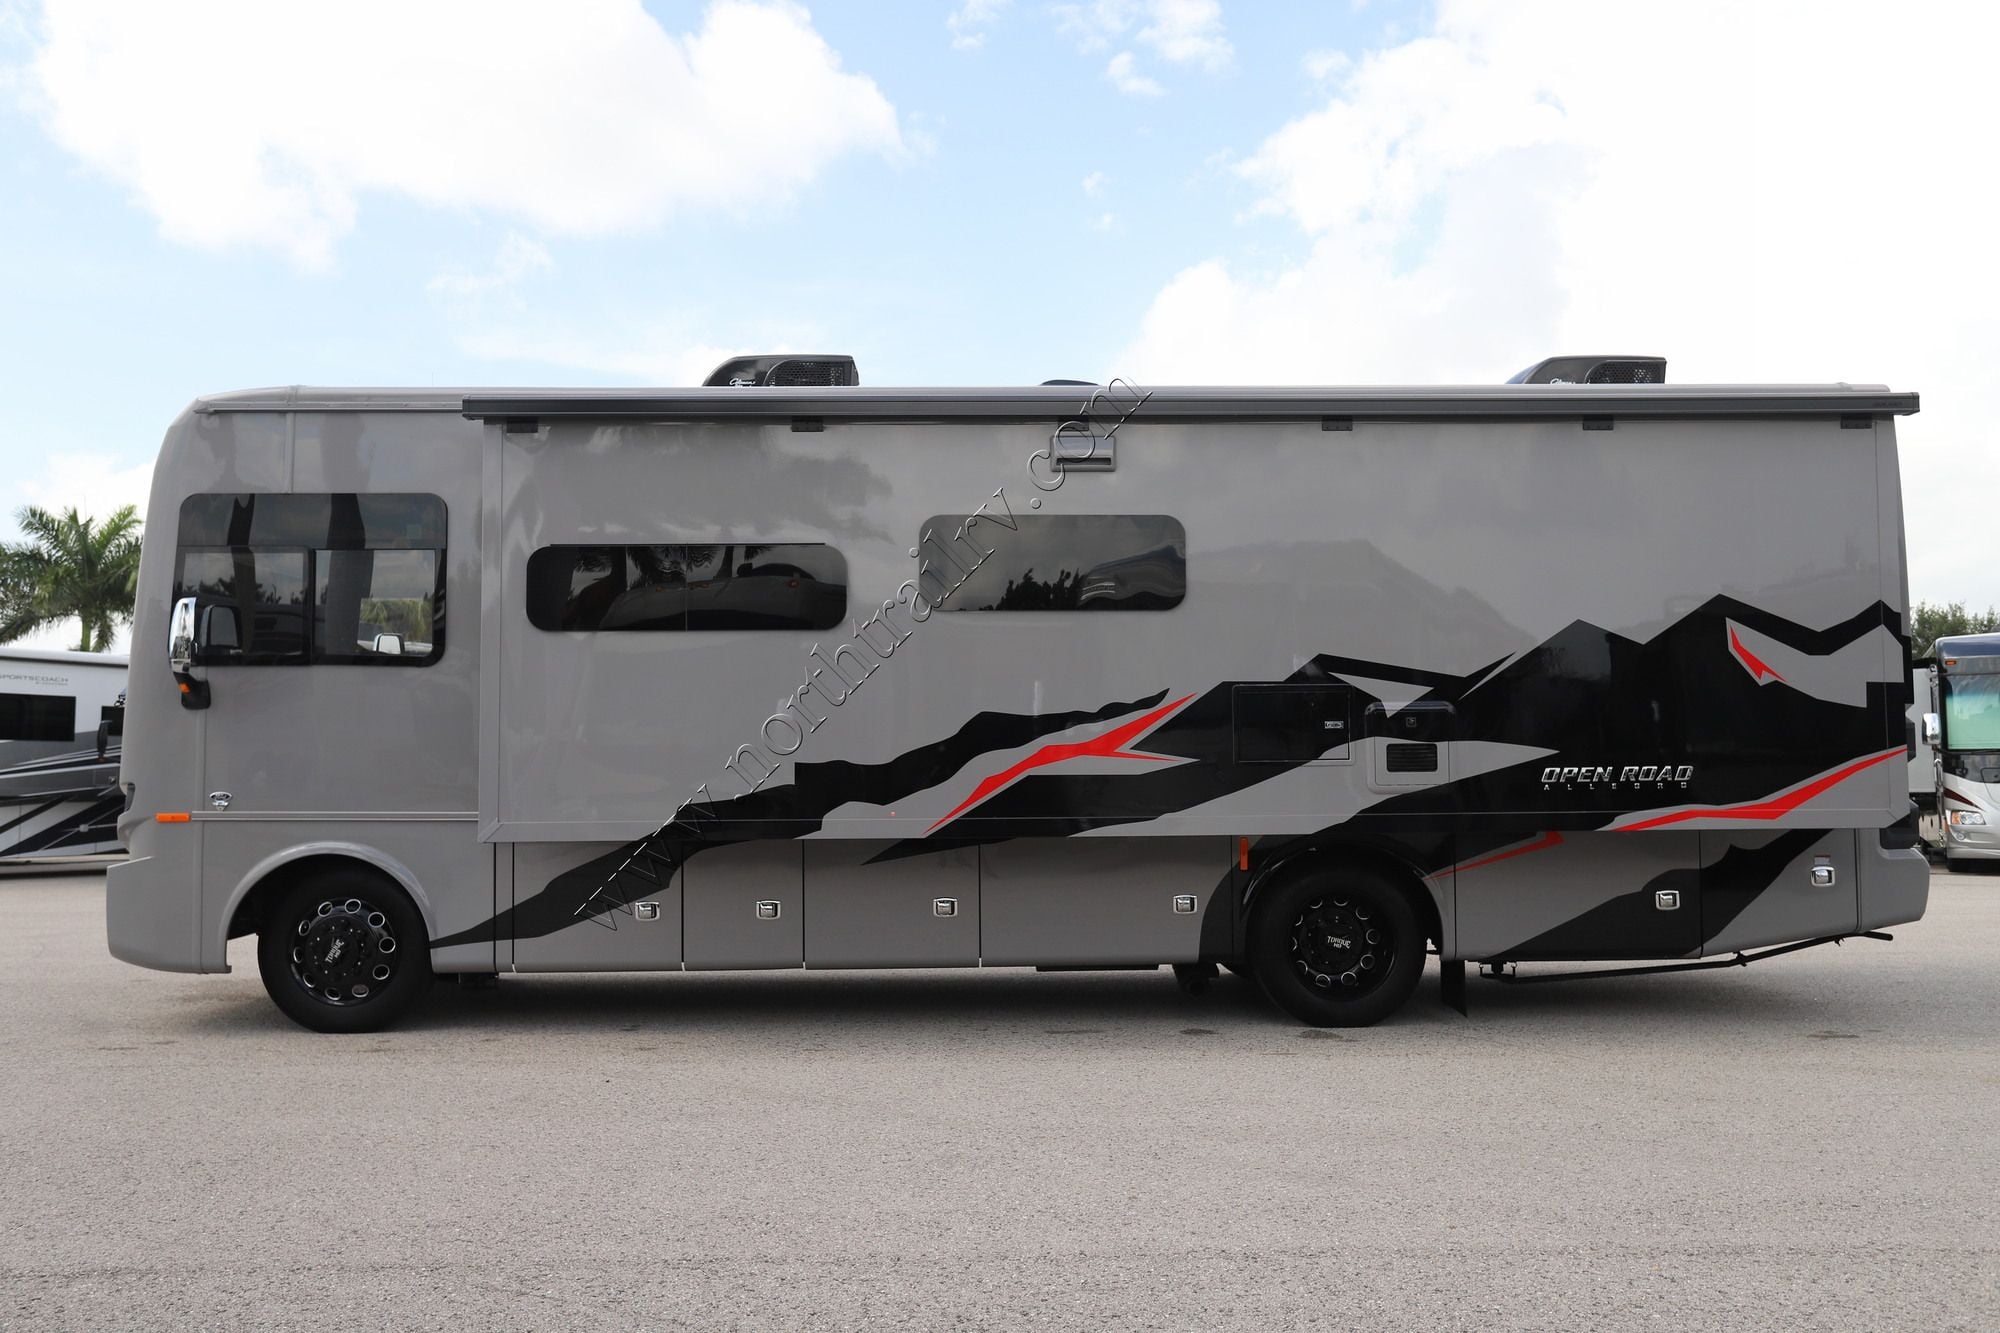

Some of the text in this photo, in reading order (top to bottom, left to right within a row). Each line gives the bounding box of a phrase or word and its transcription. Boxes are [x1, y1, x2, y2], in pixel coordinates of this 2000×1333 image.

[1541, 765, 1694, 783] OPEN ROAD
[1543, 781, 1687, 791] ALLEGRO
